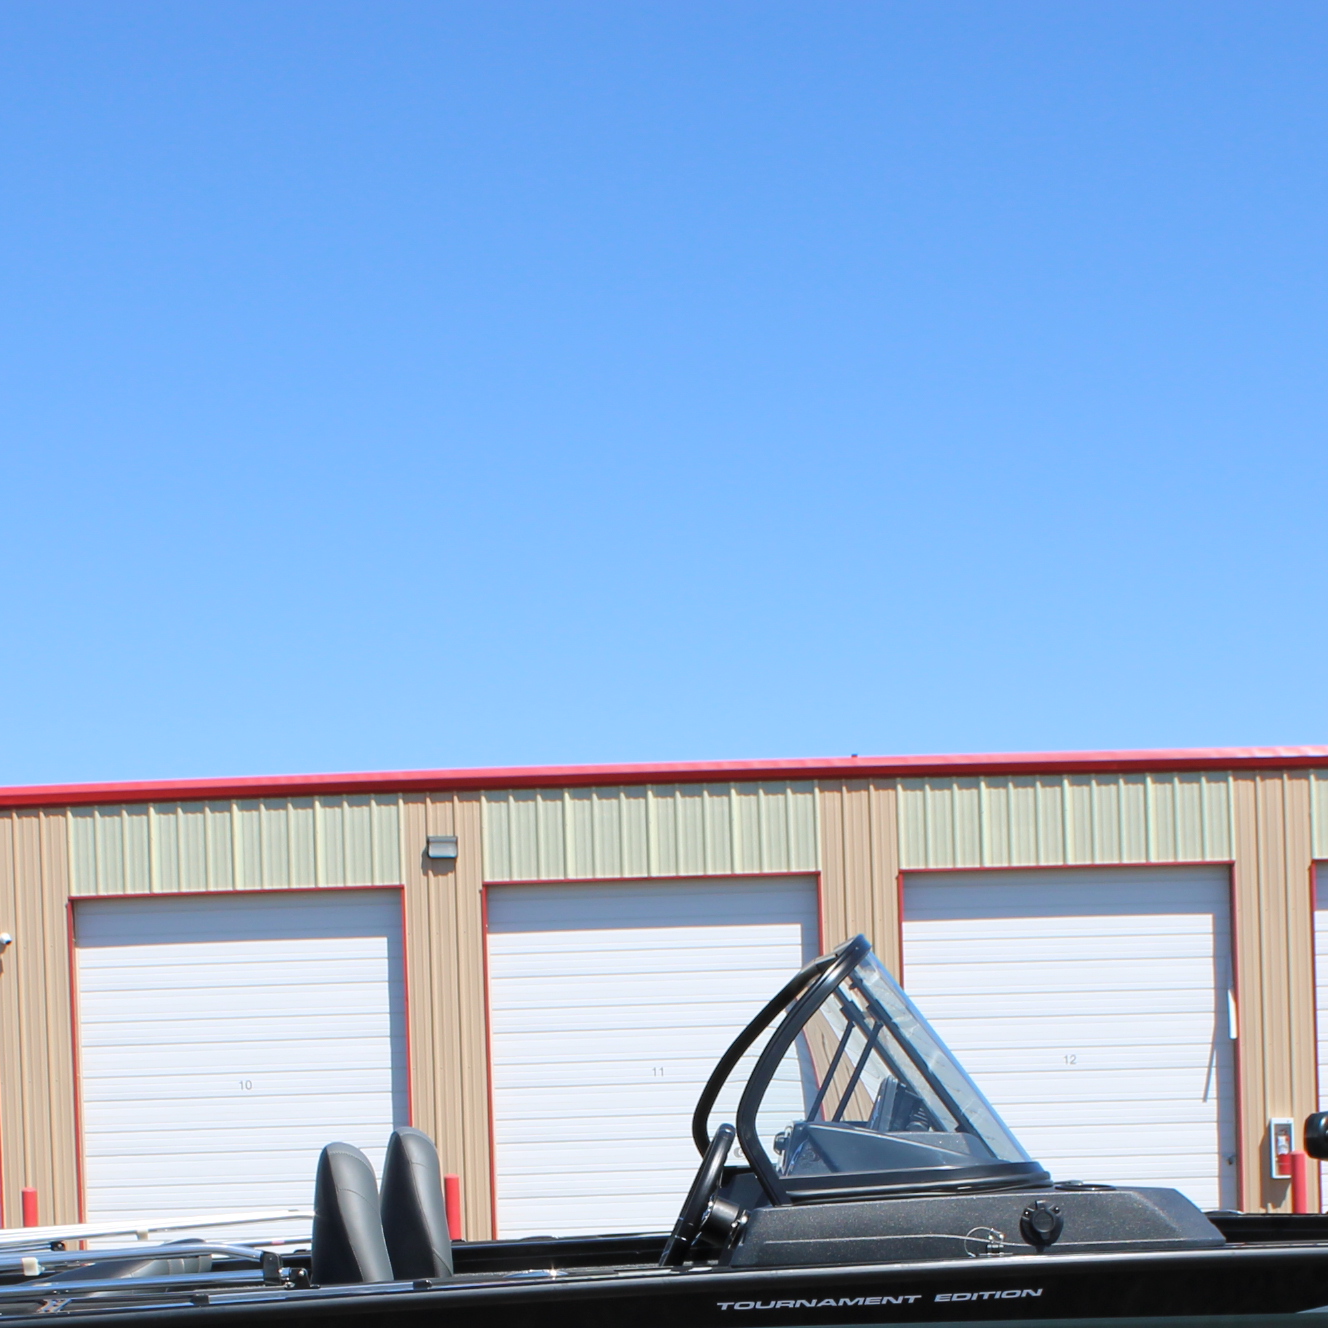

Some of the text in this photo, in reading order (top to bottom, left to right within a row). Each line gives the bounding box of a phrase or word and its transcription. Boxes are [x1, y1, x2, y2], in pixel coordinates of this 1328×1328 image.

[1063, 1055, 1077, 1065] 12
[652, 1067, 664, 1077] 11
[238, 1080, 252, 1091] 10
[716, 1288, 1044, 1311] TOURNAMENT EDITION
